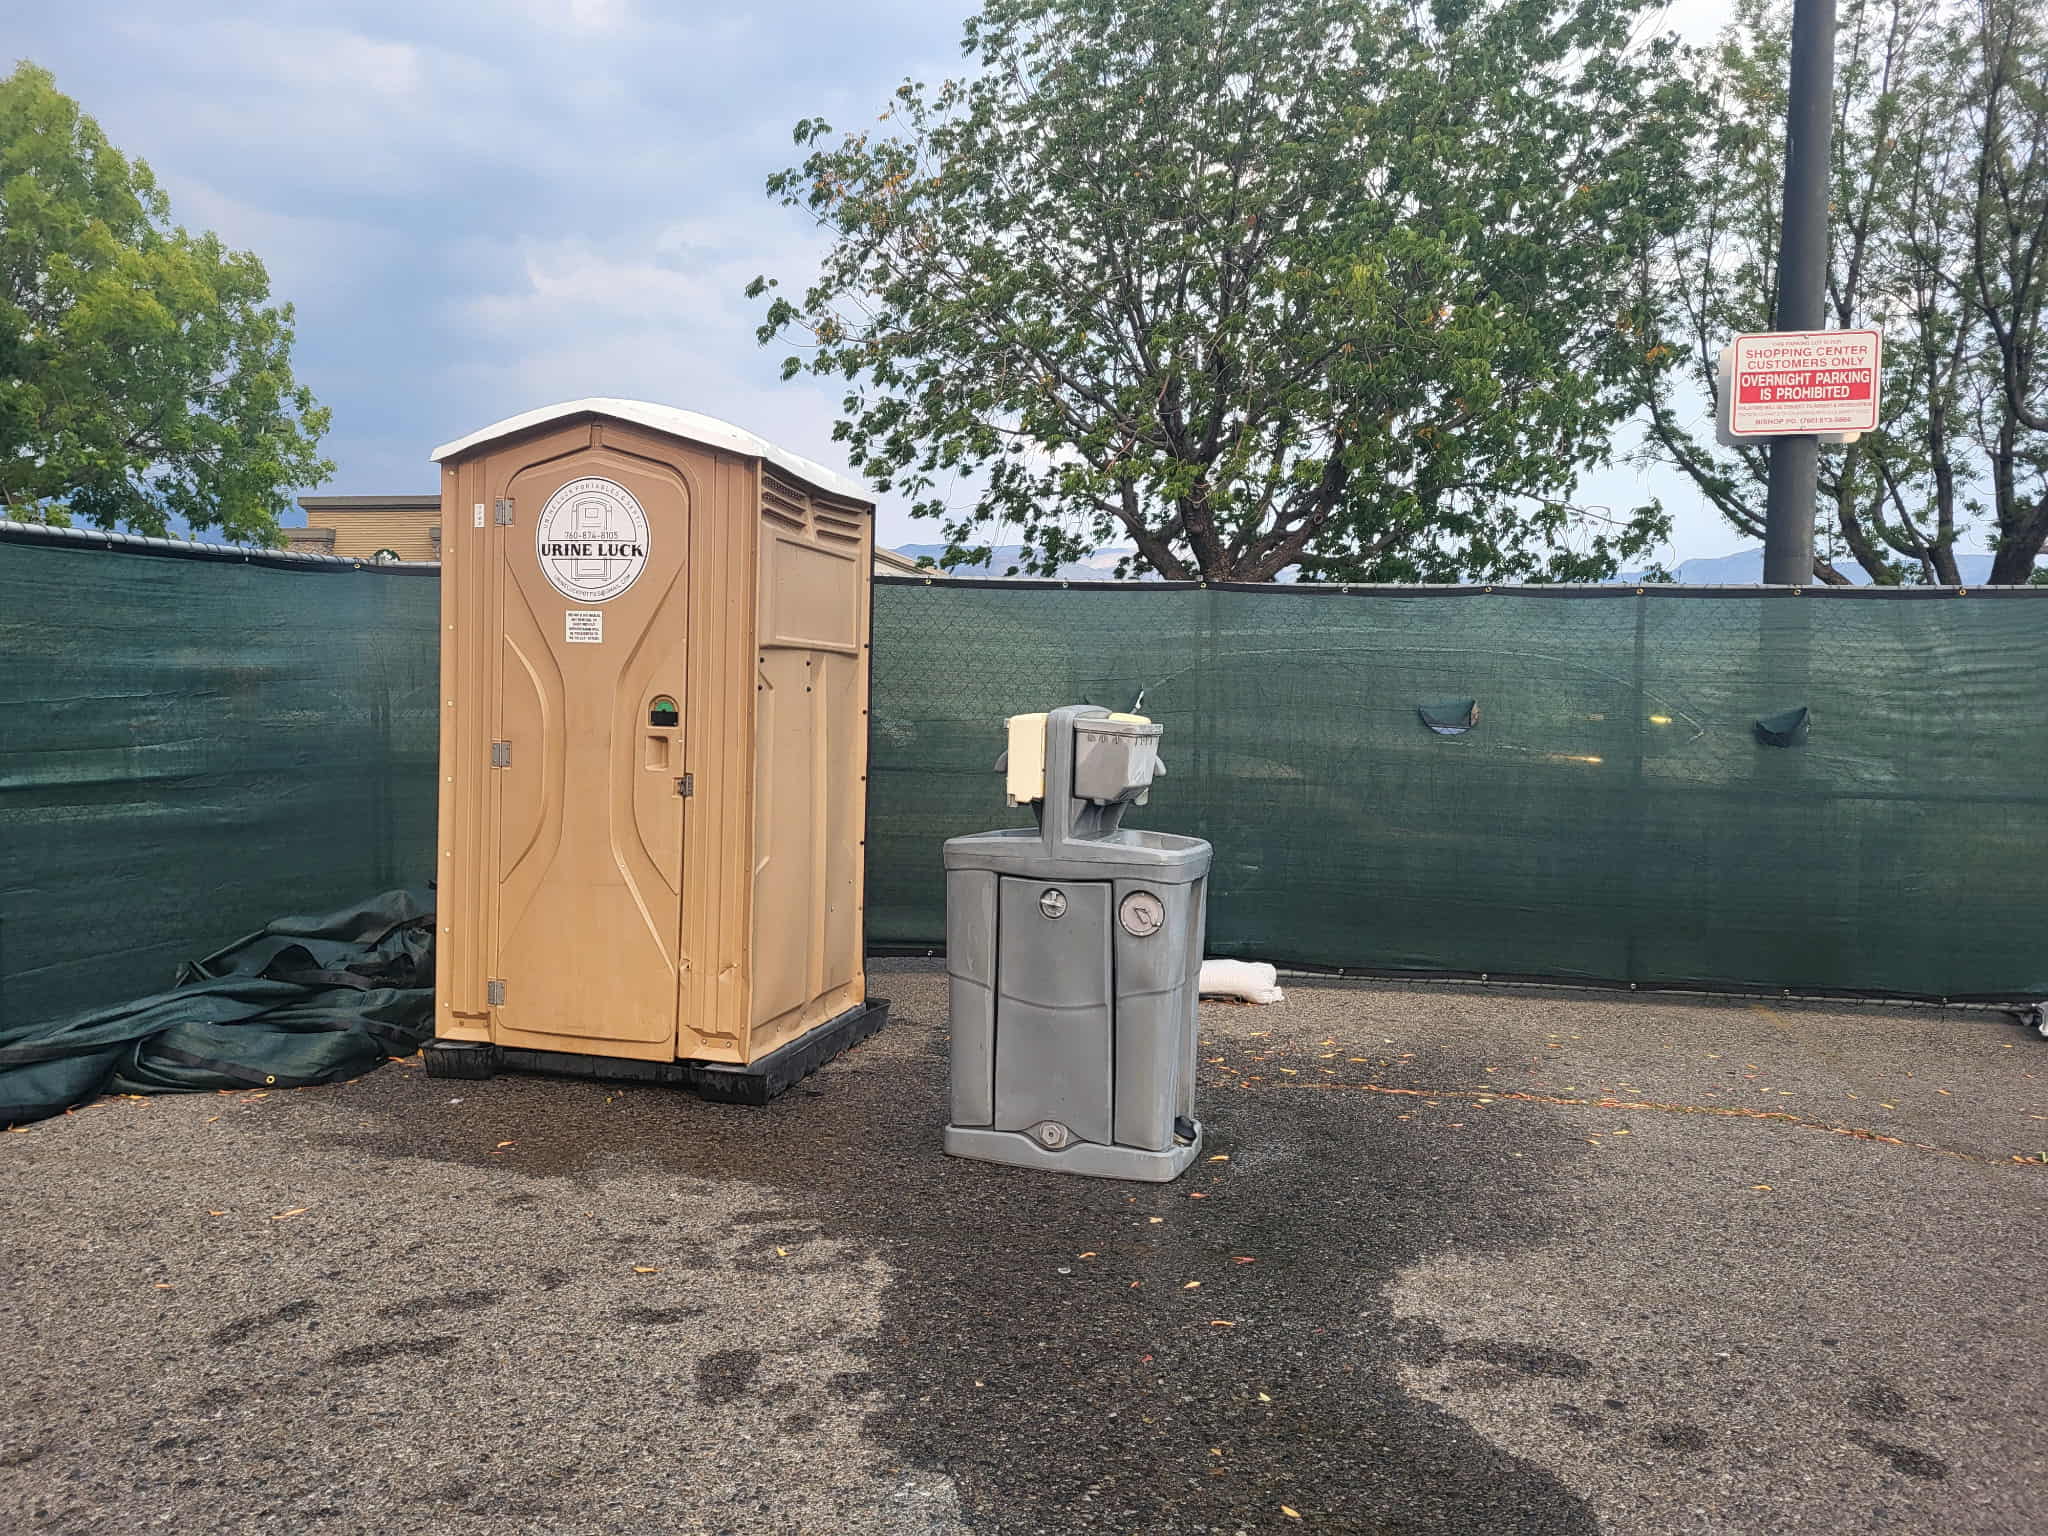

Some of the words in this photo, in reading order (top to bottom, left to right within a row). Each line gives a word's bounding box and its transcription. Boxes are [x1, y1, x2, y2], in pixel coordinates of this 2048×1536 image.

[1745, 347, 1812, 359] SHOPPING
[1816, 345, 1868, 356] CENTER
[1747, 358, 1828, 370] CUSTOMERS
[1831, 356, 1865, 367] ONLY
[1741, 373, 1812, 388] OVERNIGHT
[1816, 370, 1871, 385] PARKING
[1760, 388, 1772, 401] IS
[1776, 385, 1850, 400] PROHIBITED
[575, 483, 620, 496] PORTABLES
[541, 543, 593, 557] URINE
[598, 543, 644, 557] LUCK
